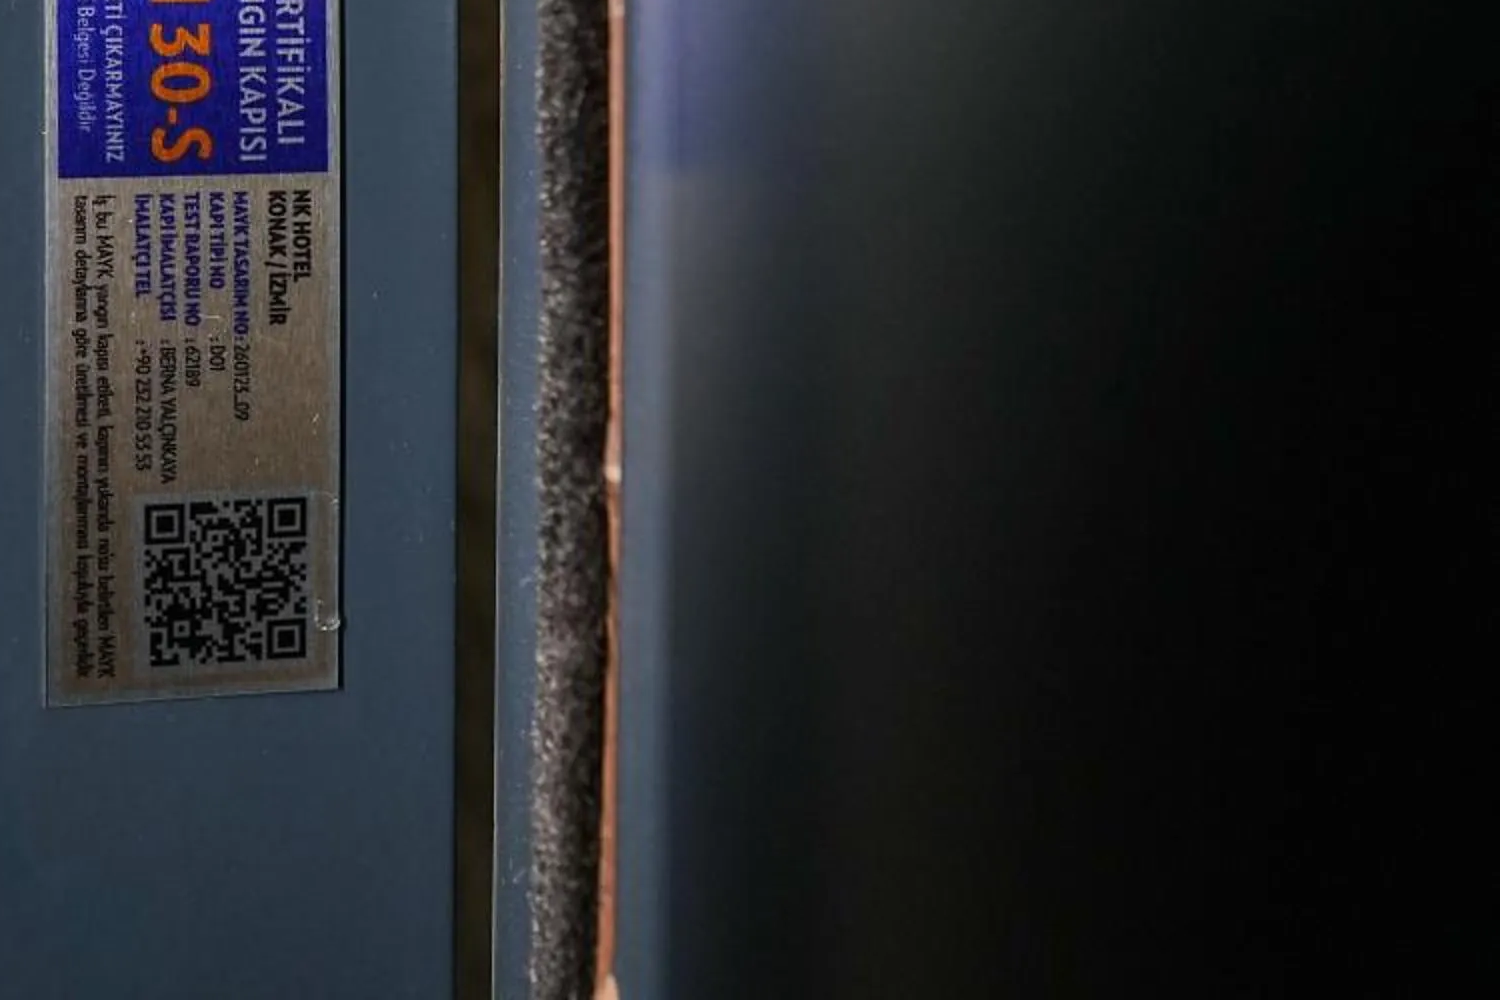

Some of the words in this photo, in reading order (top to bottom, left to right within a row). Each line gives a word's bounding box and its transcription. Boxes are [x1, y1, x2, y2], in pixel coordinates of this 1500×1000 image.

[73, 6, 96, 63] Belgesi
[74, 69, 96, 132] Değildir
[100, 25, 125, 163] ÇIKARMAYINIZ
[149, 23, 212, 162] 30-S
[239, 66, 267, 161] KAPISI
[96, 212, 114, 229] bu
[160, 193, 176, 229] KAPI
[185, 192, 200, 230] TEST
[210, 192, 225, 228] KAPI
[233, 191, 248, 236] MAYK
[268, 190, 287, 258] KONAK
[293, 190, 311, 217] NK
[96, 236, 115, 279] MAYK
[185, 233, 201, 299] RAPORU
[210, 231, 228, 262] TİPİ
[293, 221, 311, 282] HOTEL
[135, 270, 151, 299] TEL
[210, 266, 225, 289] NO
[233, 239, 249, 307] TASARIM
[93, 284, 109, 328] yangın
[185, 302, 202, 326] NO
[269, 273, 292, 325] İZMİR
[71, 328, 90, 358] göre
[75, 433, 89, 449] ve
[97, 636, 116, 678] MAYK
